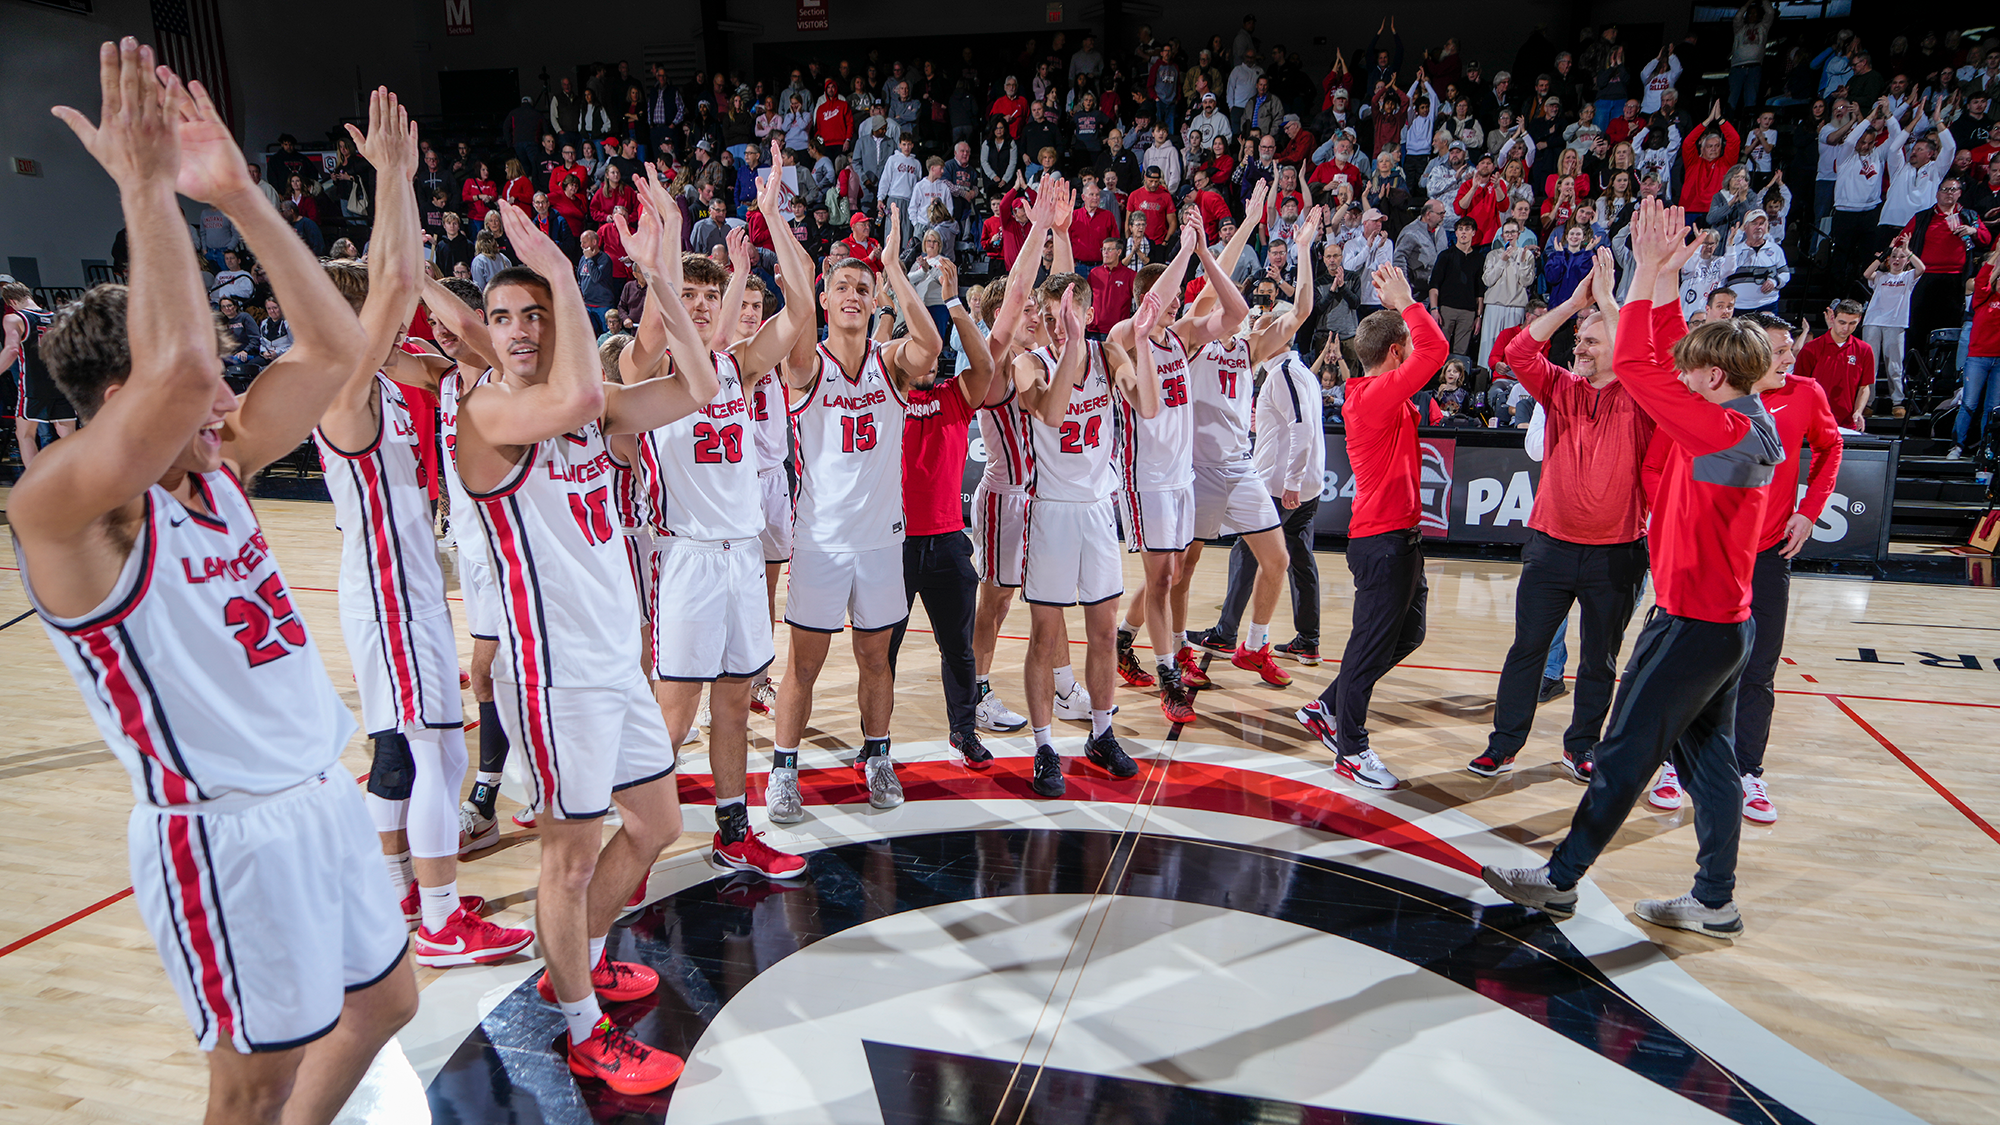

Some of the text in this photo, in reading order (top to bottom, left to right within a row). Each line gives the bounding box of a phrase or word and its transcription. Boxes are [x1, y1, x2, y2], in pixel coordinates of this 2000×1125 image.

[445, 0, 472, 25] M
[797, 20, 829, 29] VISITORS
[799, 8, 825, 16] Section
[448, 26, 472, 34] Section
[18, 160, 33, 172] EXIT
[1218, 369, 1237, 399] 11
[699, 397, 745, 419] NCERS
[823, 389, 886, 411] LANCERS
[693, 422, 743, 464] 20
[841, 412, 877, 453] 15
[1059, 415, 1102, 453] 24
[567, 485, 613, 546] 10
[224, 571, 306, 668] 25
